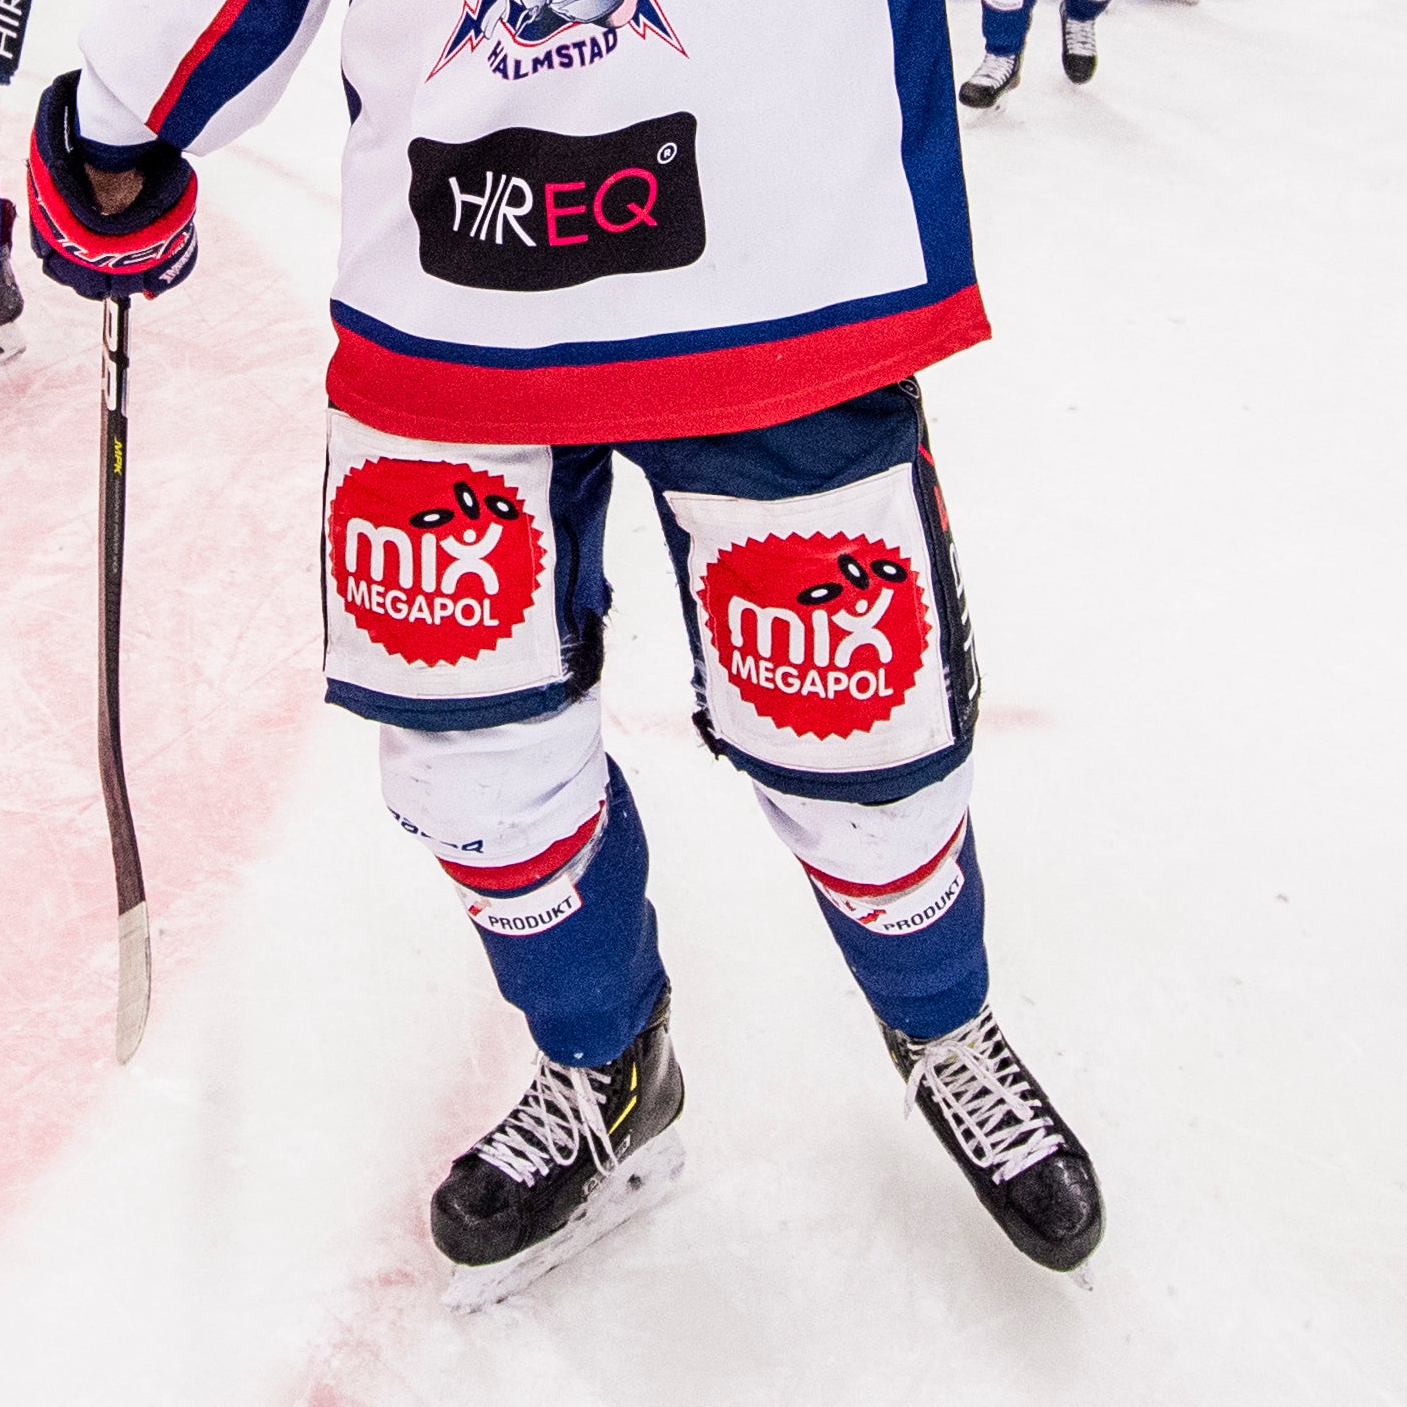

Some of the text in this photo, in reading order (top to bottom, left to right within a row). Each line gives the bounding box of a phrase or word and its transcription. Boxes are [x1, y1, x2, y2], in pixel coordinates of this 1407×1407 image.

[486, 26, 621, 81] HALMSTAD
[448, 167, 659, 248] HIREQ
[345, 516, 504, 595] mix
[346, 583, 500, 628] MEGAPOL
[728, 587, 894, 669] mix
[731, 650, 895, 700] MEGAPOL
[488, 895, 573, 931] PRODUKT
[883, 875, 961, 932] PRODUKT
